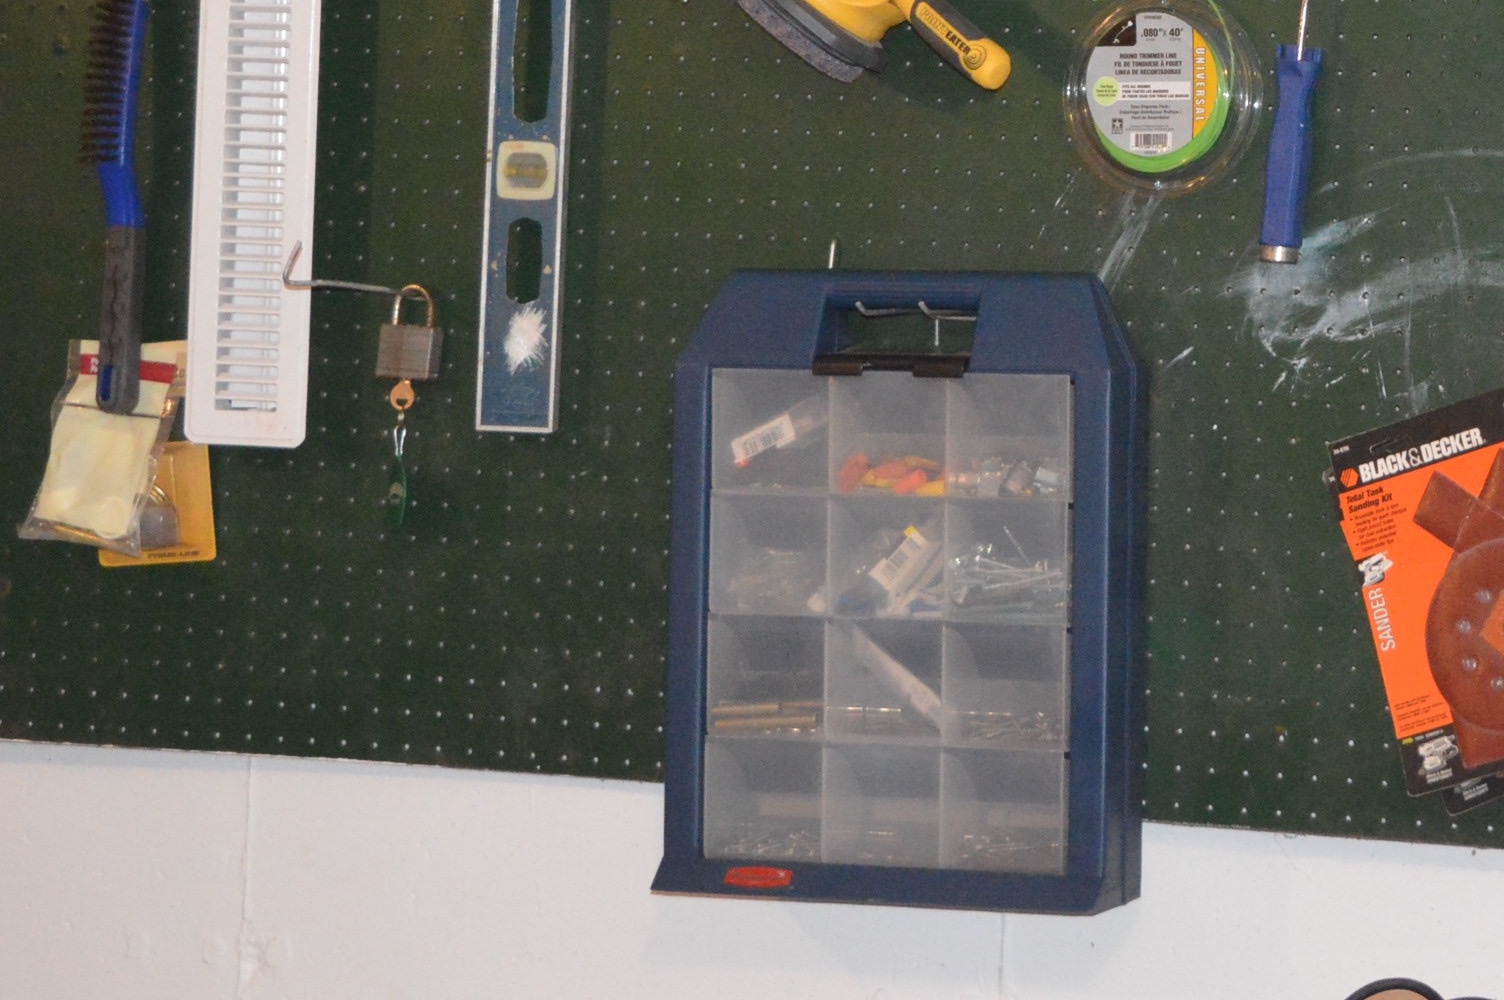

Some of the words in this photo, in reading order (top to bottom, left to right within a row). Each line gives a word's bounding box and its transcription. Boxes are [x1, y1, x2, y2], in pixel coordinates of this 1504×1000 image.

[1169, 28, 1183, 37] 40'
[1195, 47, 1206, 121] UNIVERSAL
[1359, 427, 1483, 483] BLACK&DECKER
[1346, 491, 1364, 504] Total
[1366, 486, 1384, 497] Task
[1349, 498, 1380, 514] Sanding
[1381, 493, 1393, 504] Kit
[1369, 588, 1396, 651] SANDER
